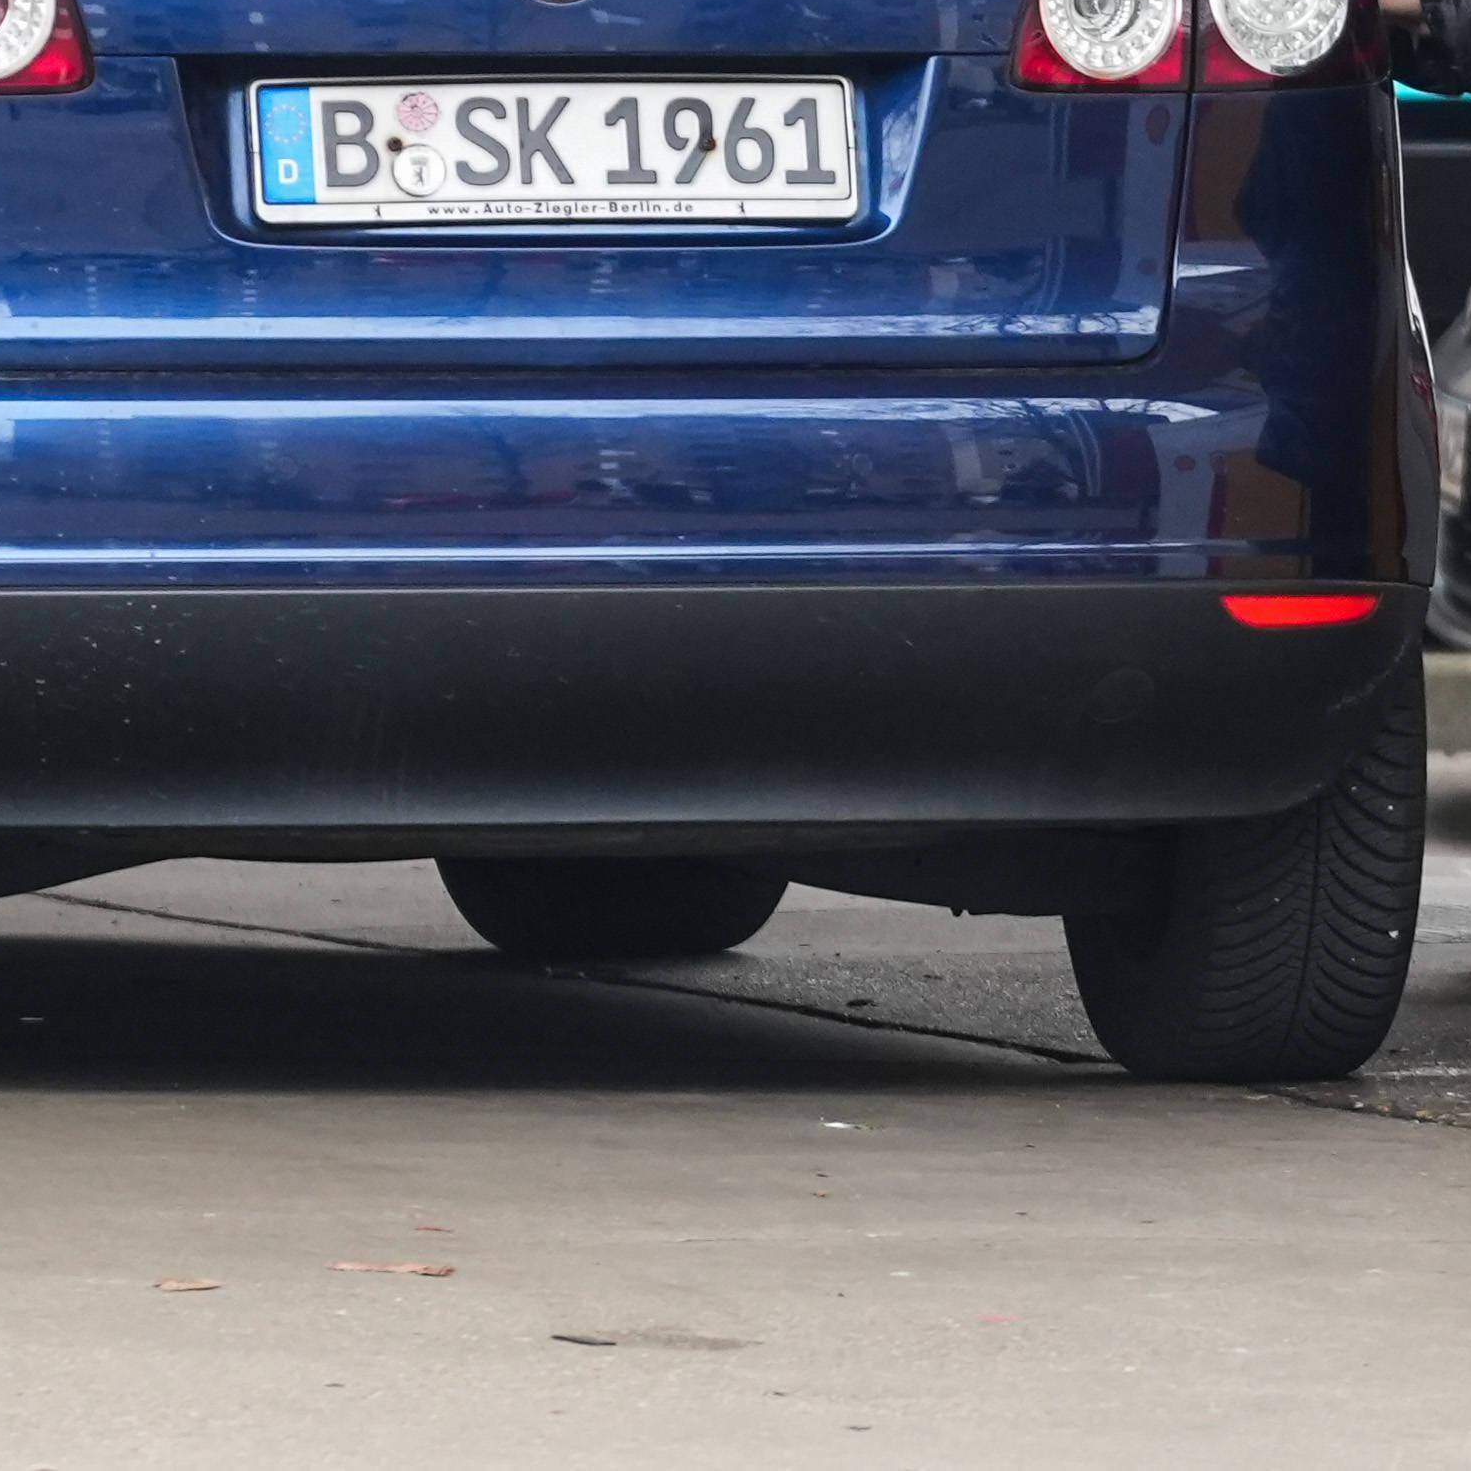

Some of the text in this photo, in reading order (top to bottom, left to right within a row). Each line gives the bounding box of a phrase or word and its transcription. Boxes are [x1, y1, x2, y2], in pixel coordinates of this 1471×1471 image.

[276, 95, 837, 188] D B SK 1961
[427, 201, 694, 217] www.Auto-Ziegler-Berlin.de
